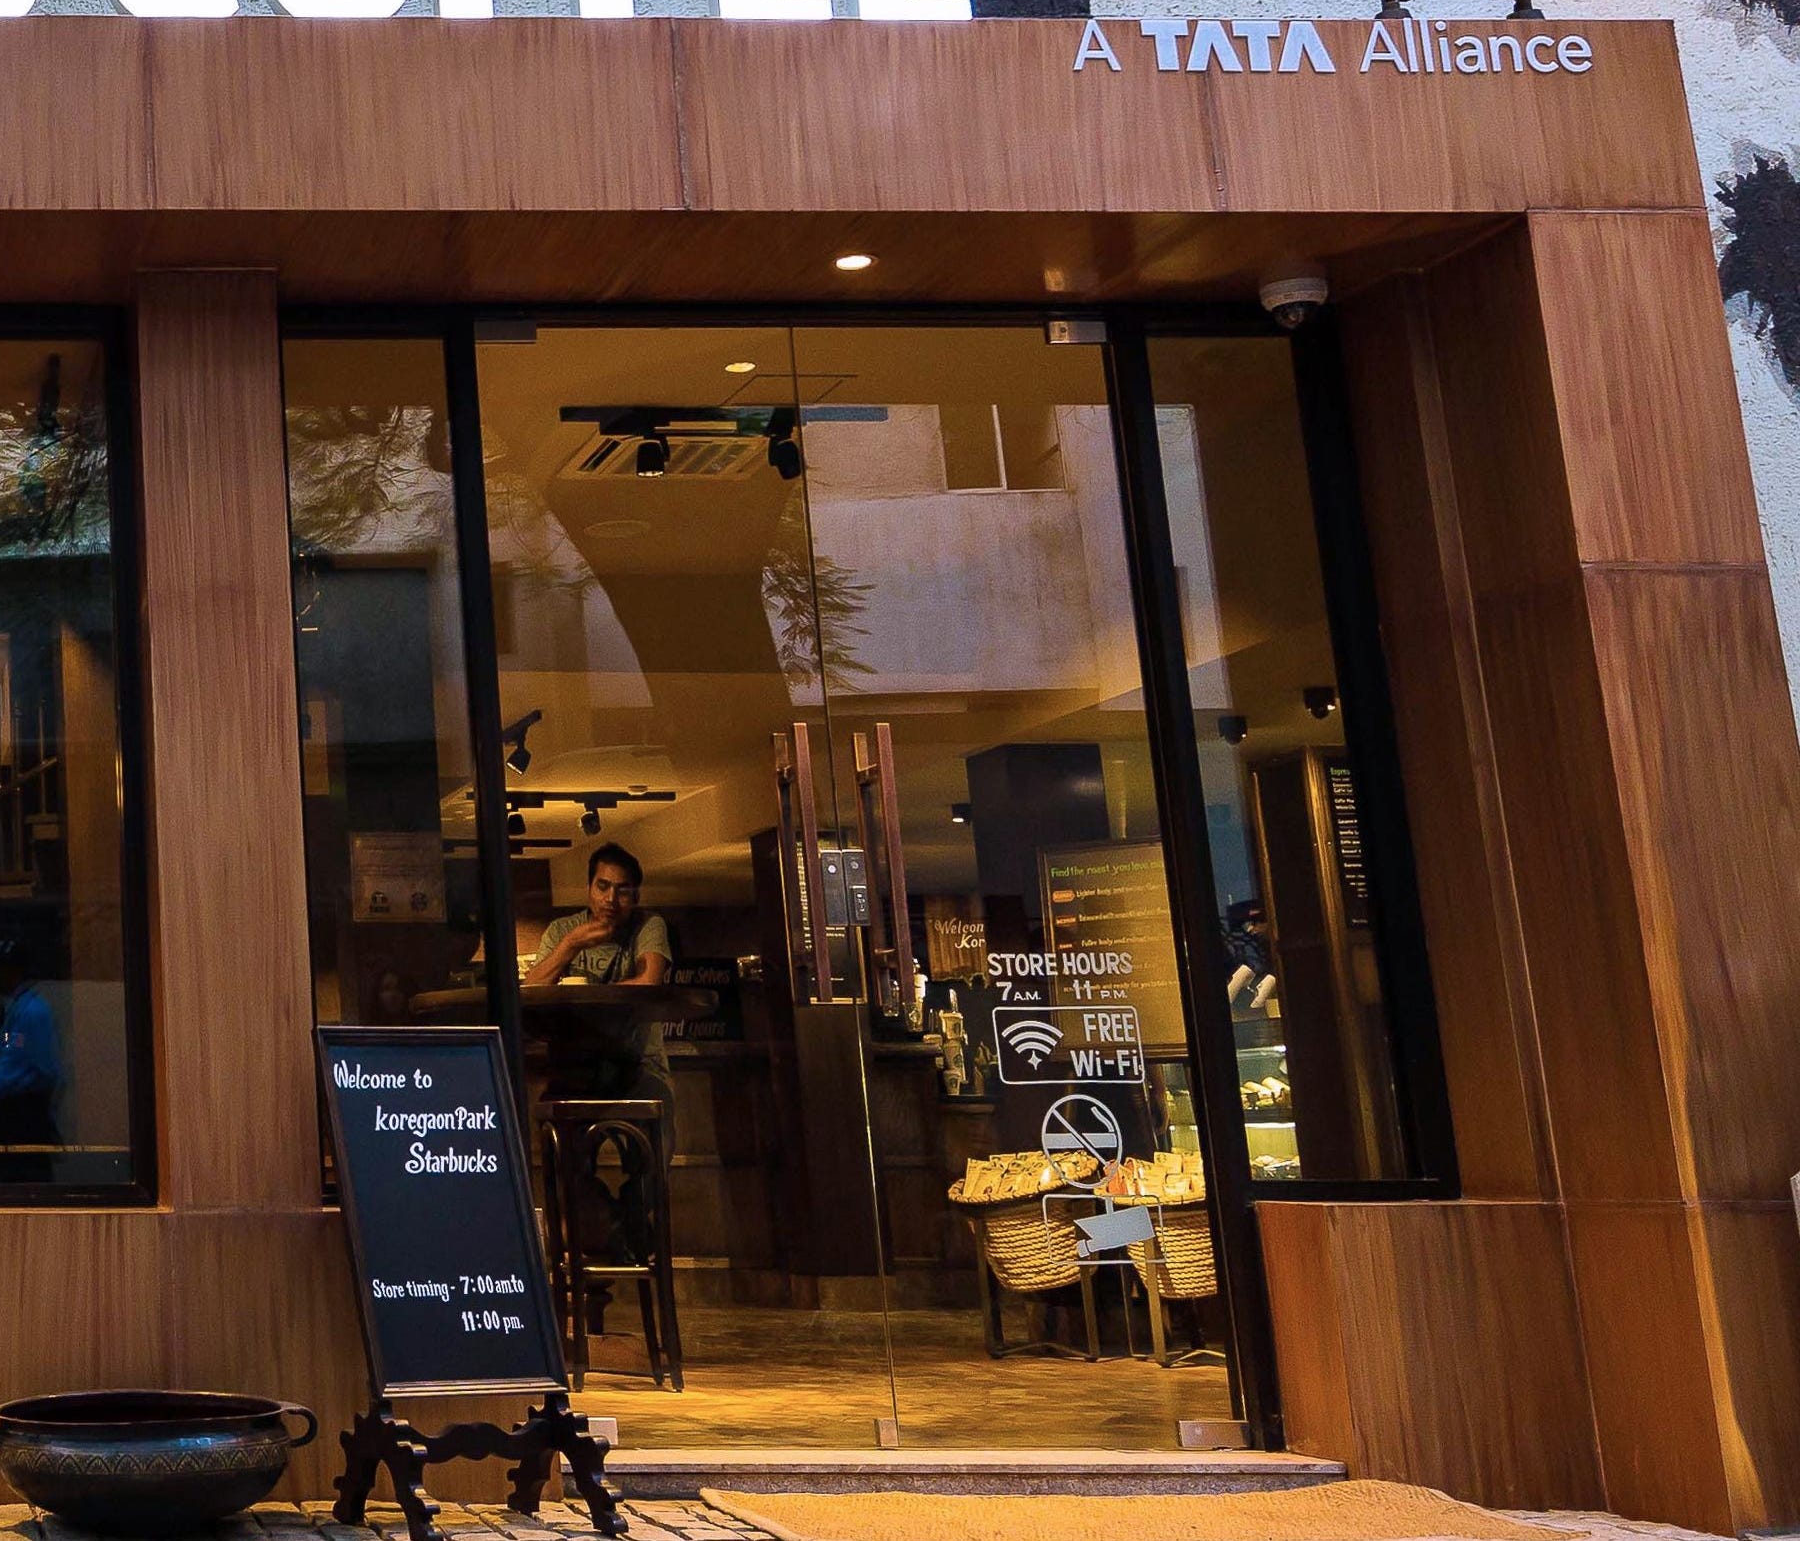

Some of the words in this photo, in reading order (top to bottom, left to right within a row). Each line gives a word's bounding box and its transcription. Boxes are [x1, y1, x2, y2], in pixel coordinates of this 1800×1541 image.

[1073, 18, 1122, 71] A
[1140, 18, 1336, 73] TATA
[1359, 17, 1594, 74] Alliance
[987, 952, 1058, 977] STORE
[1061, 951, 1133, 975] HOURS
[996, 981, 1013, 1001] 7
[1013, 990, 1042, 1001] A.M.
[1072, 979, 1092, 1000] 11
[1100, 989, 1128, 1000] P.M.
[1083, 1012, 1136, 1042] FREE
[333, 1059, 406, 1090] Welcome
[413, 1068, 433, 1089] to
[1070, 1050, 1140, 1077] Wi-Fi
[454, 1105, 497, 1130] Park
[404, 1141, 498, 1174] Starbucks
[372, 1278, 405, 1299] Store
[459, 1274, 494, 1295] 7:00
[461, 1310, 501, 1332] 11:00
